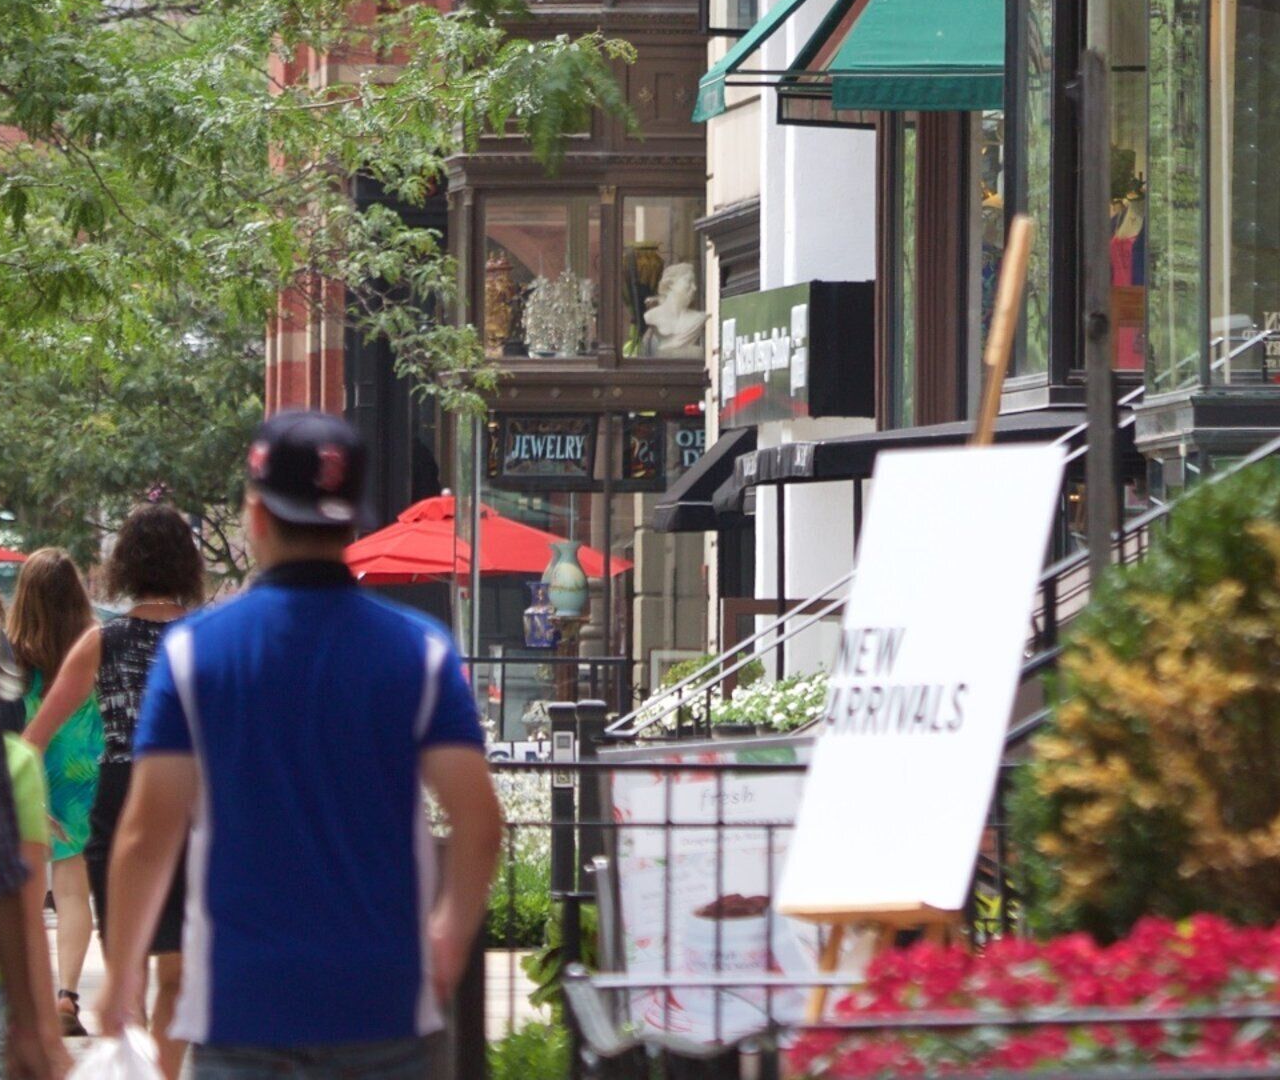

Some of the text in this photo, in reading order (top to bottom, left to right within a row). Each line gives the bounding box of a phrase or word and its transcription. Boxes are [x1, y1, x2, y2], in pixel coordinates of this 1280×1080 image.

[511, 434, 586, 460] JEWELRY
[832, 627, 906, 677] NEW
[823, 683, 970, 735] ARRIVALS
